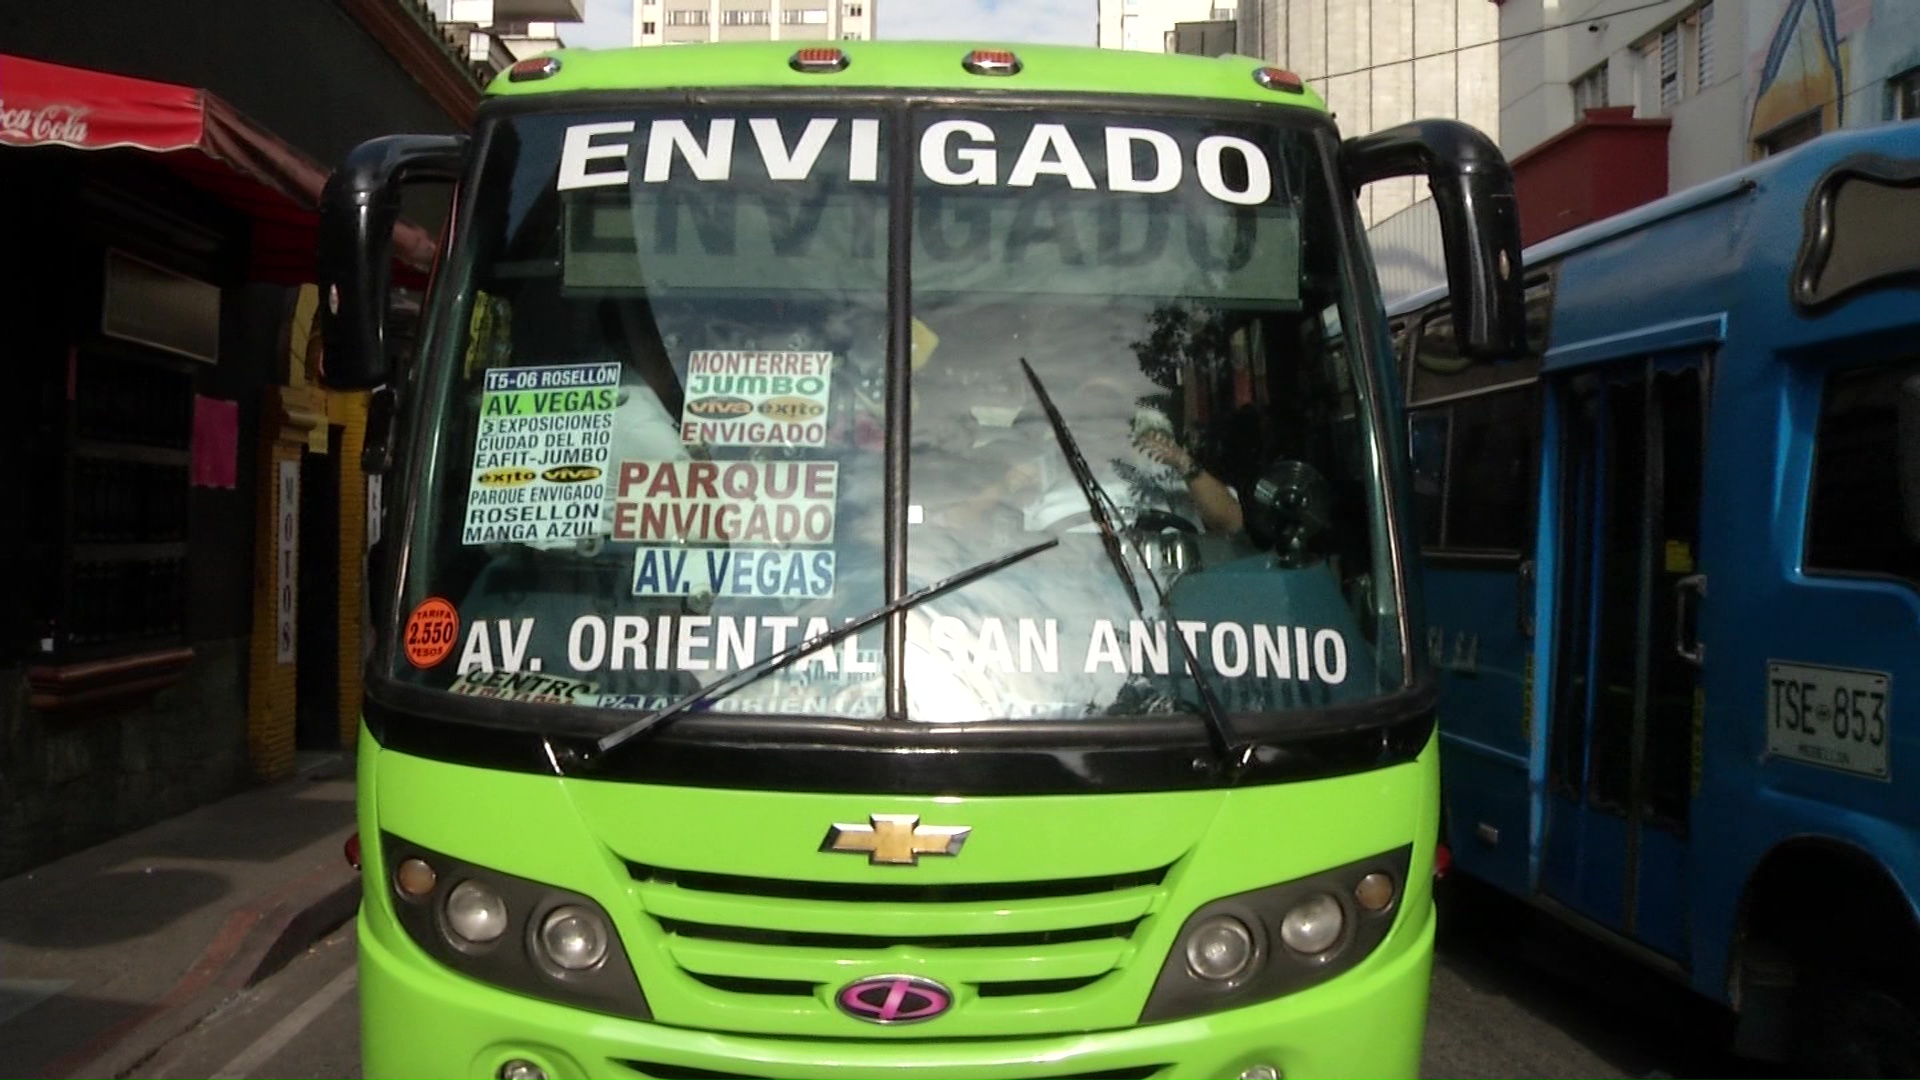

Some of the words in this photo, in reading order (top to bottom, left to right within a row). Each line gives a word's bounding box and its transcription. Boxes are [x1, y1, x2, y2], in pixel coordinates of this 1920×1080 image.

[691, 352, 829, 374] MONTERREY
[489, 371, 537, 390] T5-06
[690, 375, 824, 395] JUMBO
[487, 394, 523, 417] AV.
[533, 390, 612, 413] VEGAS
[498, 413, 612, 434] EXPOSICIONES
[682, 422, 823, 443] ENVIGADO
[478, 434, 539, 451] CIUDAD
[544, 432, 574, 448] DEL
[475, 447, 608, 469] EAFIT-JUMBO
[617, 462, 837, 501] PARQUE
[470, 487, 524, 505] PARQUE
[530, 484, 604, 502] ENVIGADO
[470, 502, 599, 525] ROSELLÓN
[613, 502, 833, 541] ENVIGADO
[465, 523, 537, 542] MANGA
[546, 520, 597, 538] AZUL
[635, 549, 690, 594] AV.
[706, 549, 833, 596] VEGAS
[417, 609, 451, 620] TARIFA
[409, 622, 453, 645] 2.550
[457, 617, 542, 676] AV.
[568, 615, 877, 674] ORIENTAL
[930, 615, 1059, 674] SAN
[1084, 618, 1348, 685] ANTONIO
[1771, 678, 1816, 736] TSE
[1833, 687, 1884, 746] 853
